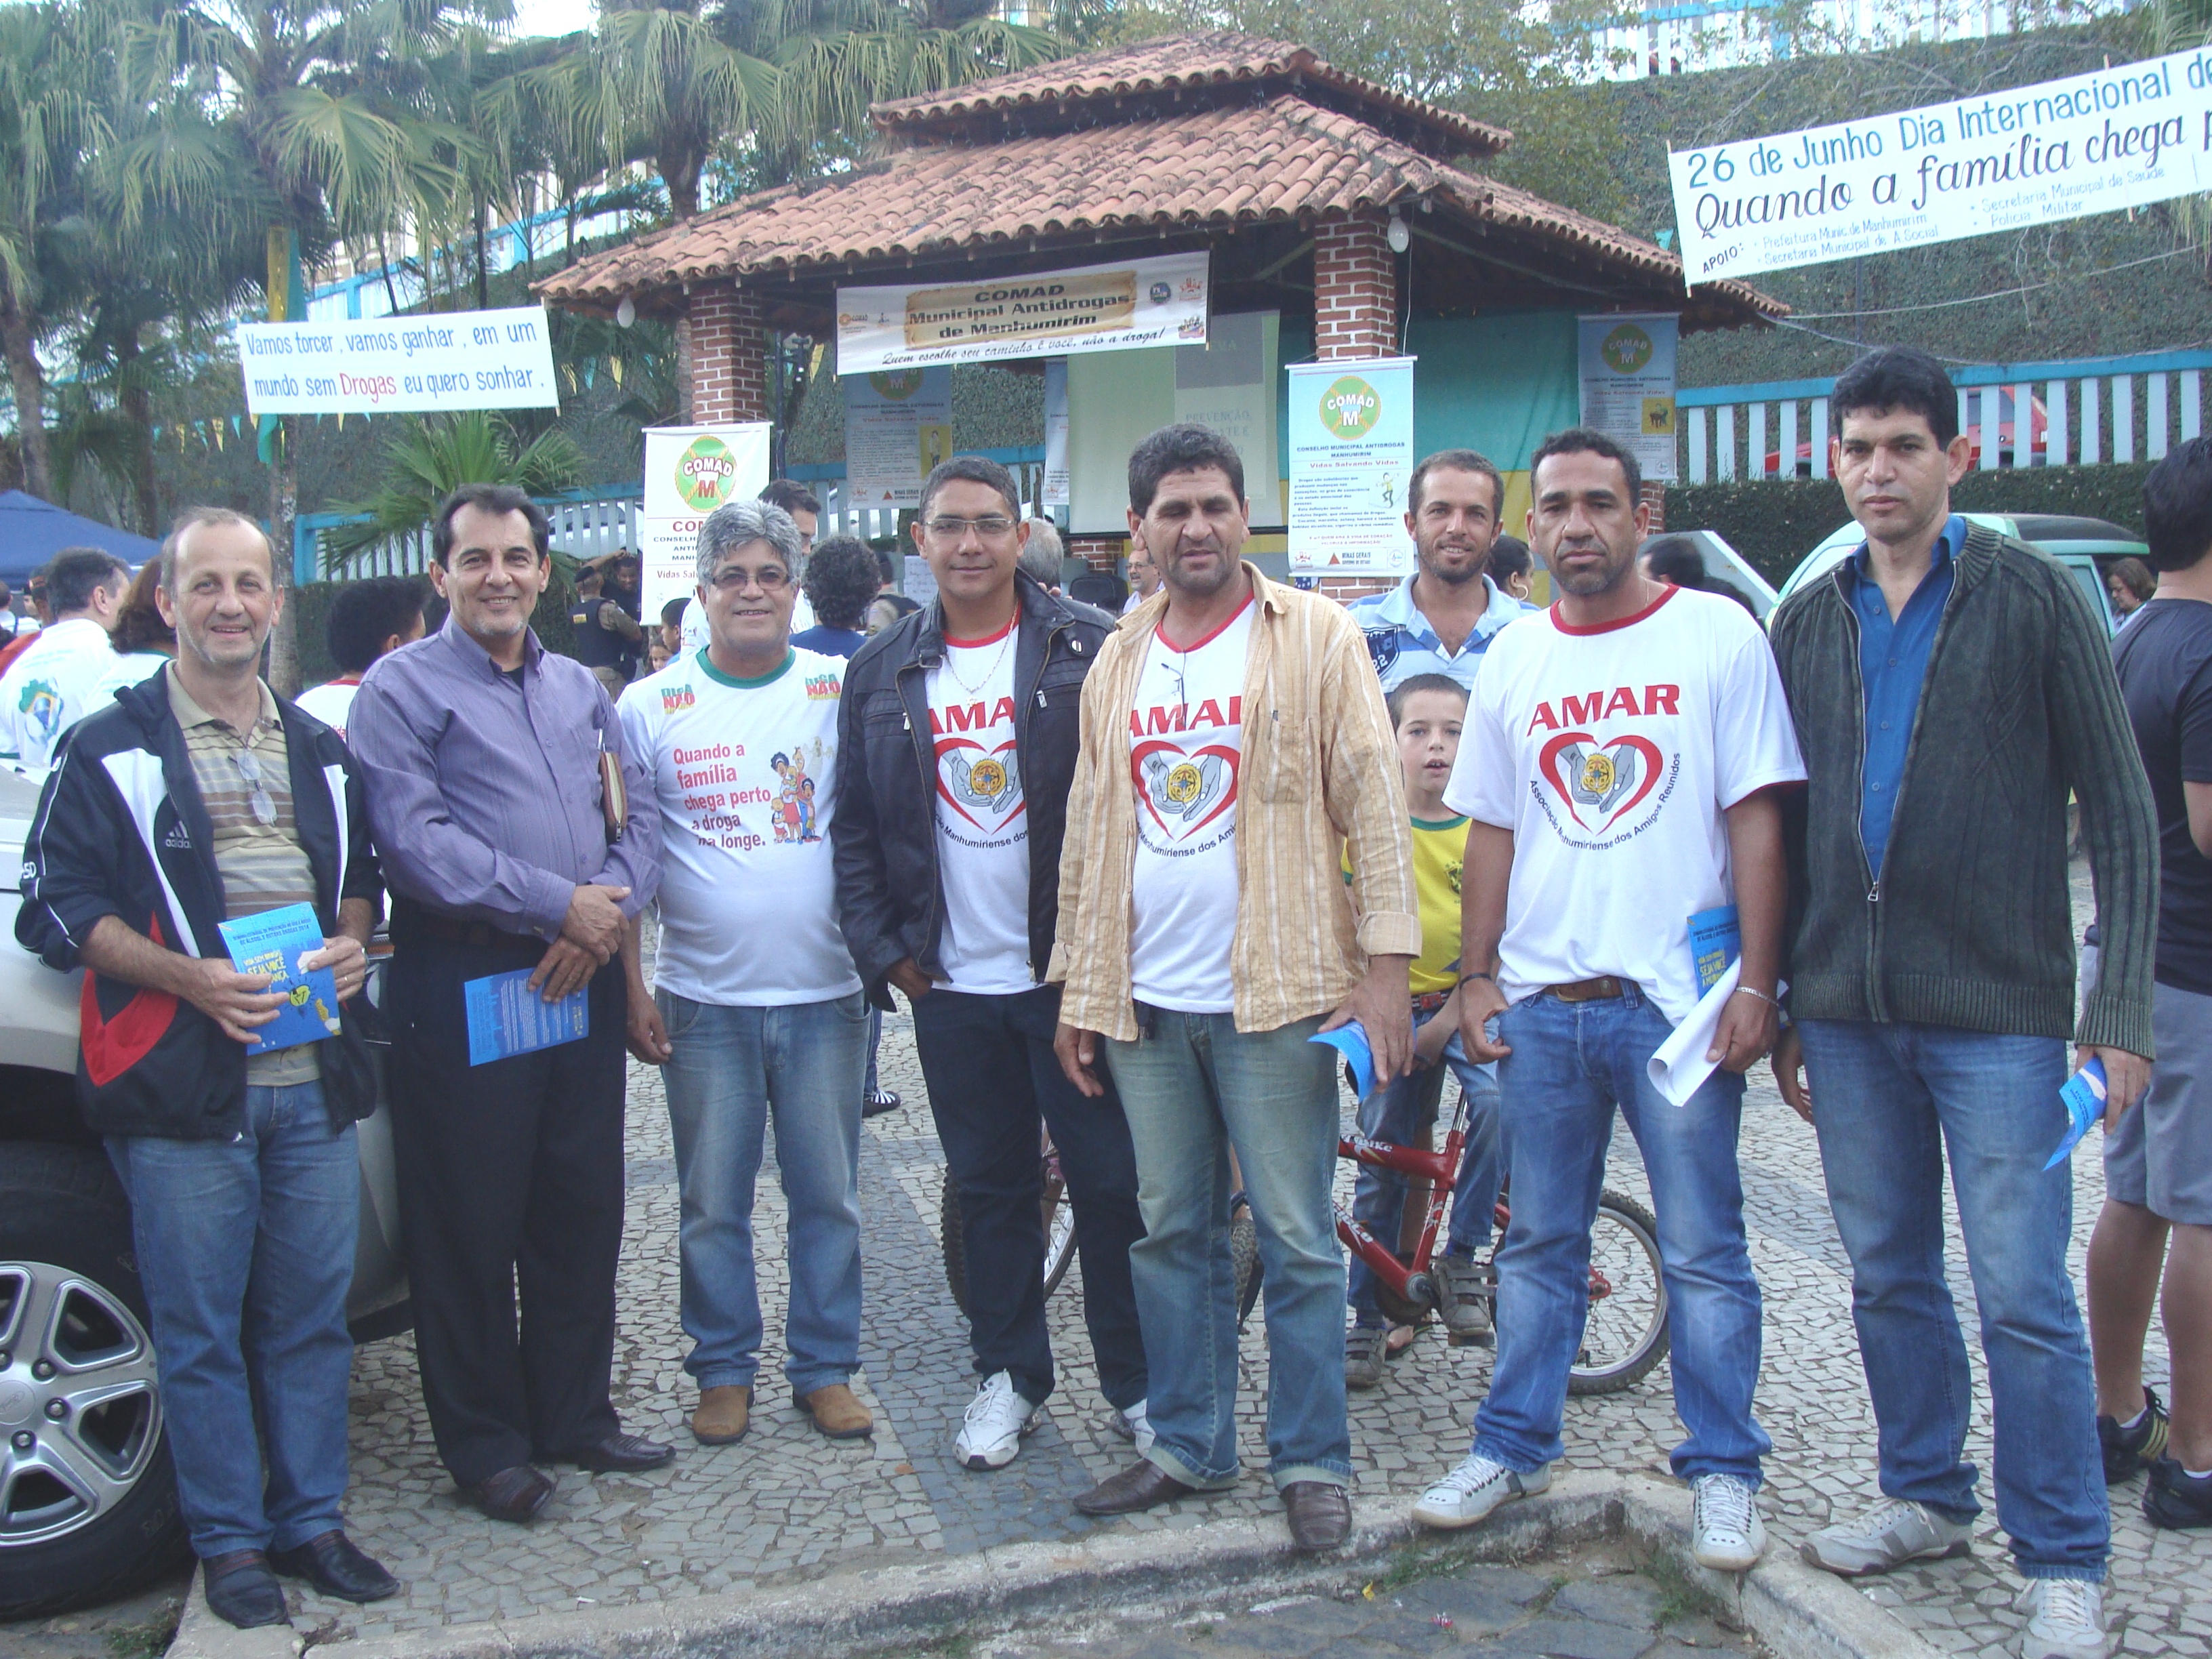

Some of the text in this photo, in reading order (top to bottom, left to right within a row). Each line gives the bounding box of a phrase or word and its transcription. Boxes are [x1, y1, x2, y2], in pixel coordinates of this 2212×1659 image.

[1687, 148, 1734, 188] 26
[1749, 142, 1782, 176] de
[1793, 127, 1883, 169] Junho
[1899, 115, 1945, 151] Dia
[1957, 62, 2171, 140] Internacional
[1696, 174, 1856, 239] Quando
[1872, 173, 1902, 205] a
[1912, 134, 2075, 210] família
[2085, 116, 2188, 167] chega
[1982, 190, 2047, 213] Secretaria
[2052, 176, 2104, 199] Municipal
[2108, 173, 2123, 188] de
[2042, 200, 2083, 218] Militar
[1763, 231, 1817, 249] Prefeitura
[1862, 213, 1927, 233] Manhumirim
[1764, 245, 1817, 266] Secretaria
[1821, 237, 1870, 257] Municipal
[1875, 234, 1887, 247] de
[975, 284, 1065, 303] COMAD
[909, 292, 1130, 325] Municipal Antidrogas
[245, 331, 292, 356] Vamos
[346, 332, 398, 353] vamos
[473, 325, 499, 346] em
[506, 321, 537, 343] um
[939, 314, 1097, 340] de Manhumirim
[882, 352, 915, 366] Quem
[918, 347, 958, 363] escolhe
[961, 348, 980, 359] seu
[984, 342, 1032, 356] caminho
[1082, 335, 1105, 346] não
[254, 373, 299, 397] mundo
[306, 377, 337, 396] sem
[340, 373, 397, 404] Drogas
[405, 375, 424, 394] eu
[427, 373, 470, 399] quero
[1327, 394, 1375, 411] COMAD
[1343, 411, 1359, 426] M
[683, 457, 733, 477] COMAD
[698, 480, 716, 498] M
[657, 570, 680, 579] Vidas
[1526, 684, 1680, 738] AMAR
[673, 743, 745, 764] Quando a
[676, 764, 737, 790] família
[684, 786, 771, 813] chega perto
[1614, 832, 1632, 845] dos
[1633, 803, 1662, 836] Amigos
[1658, 752, 1680, 803] Reunidos
[691, 814, 741, 832] a droga
[943, 825, 1011, 849] Manhumiriense
[1198, 840, 1217, 854] dos
